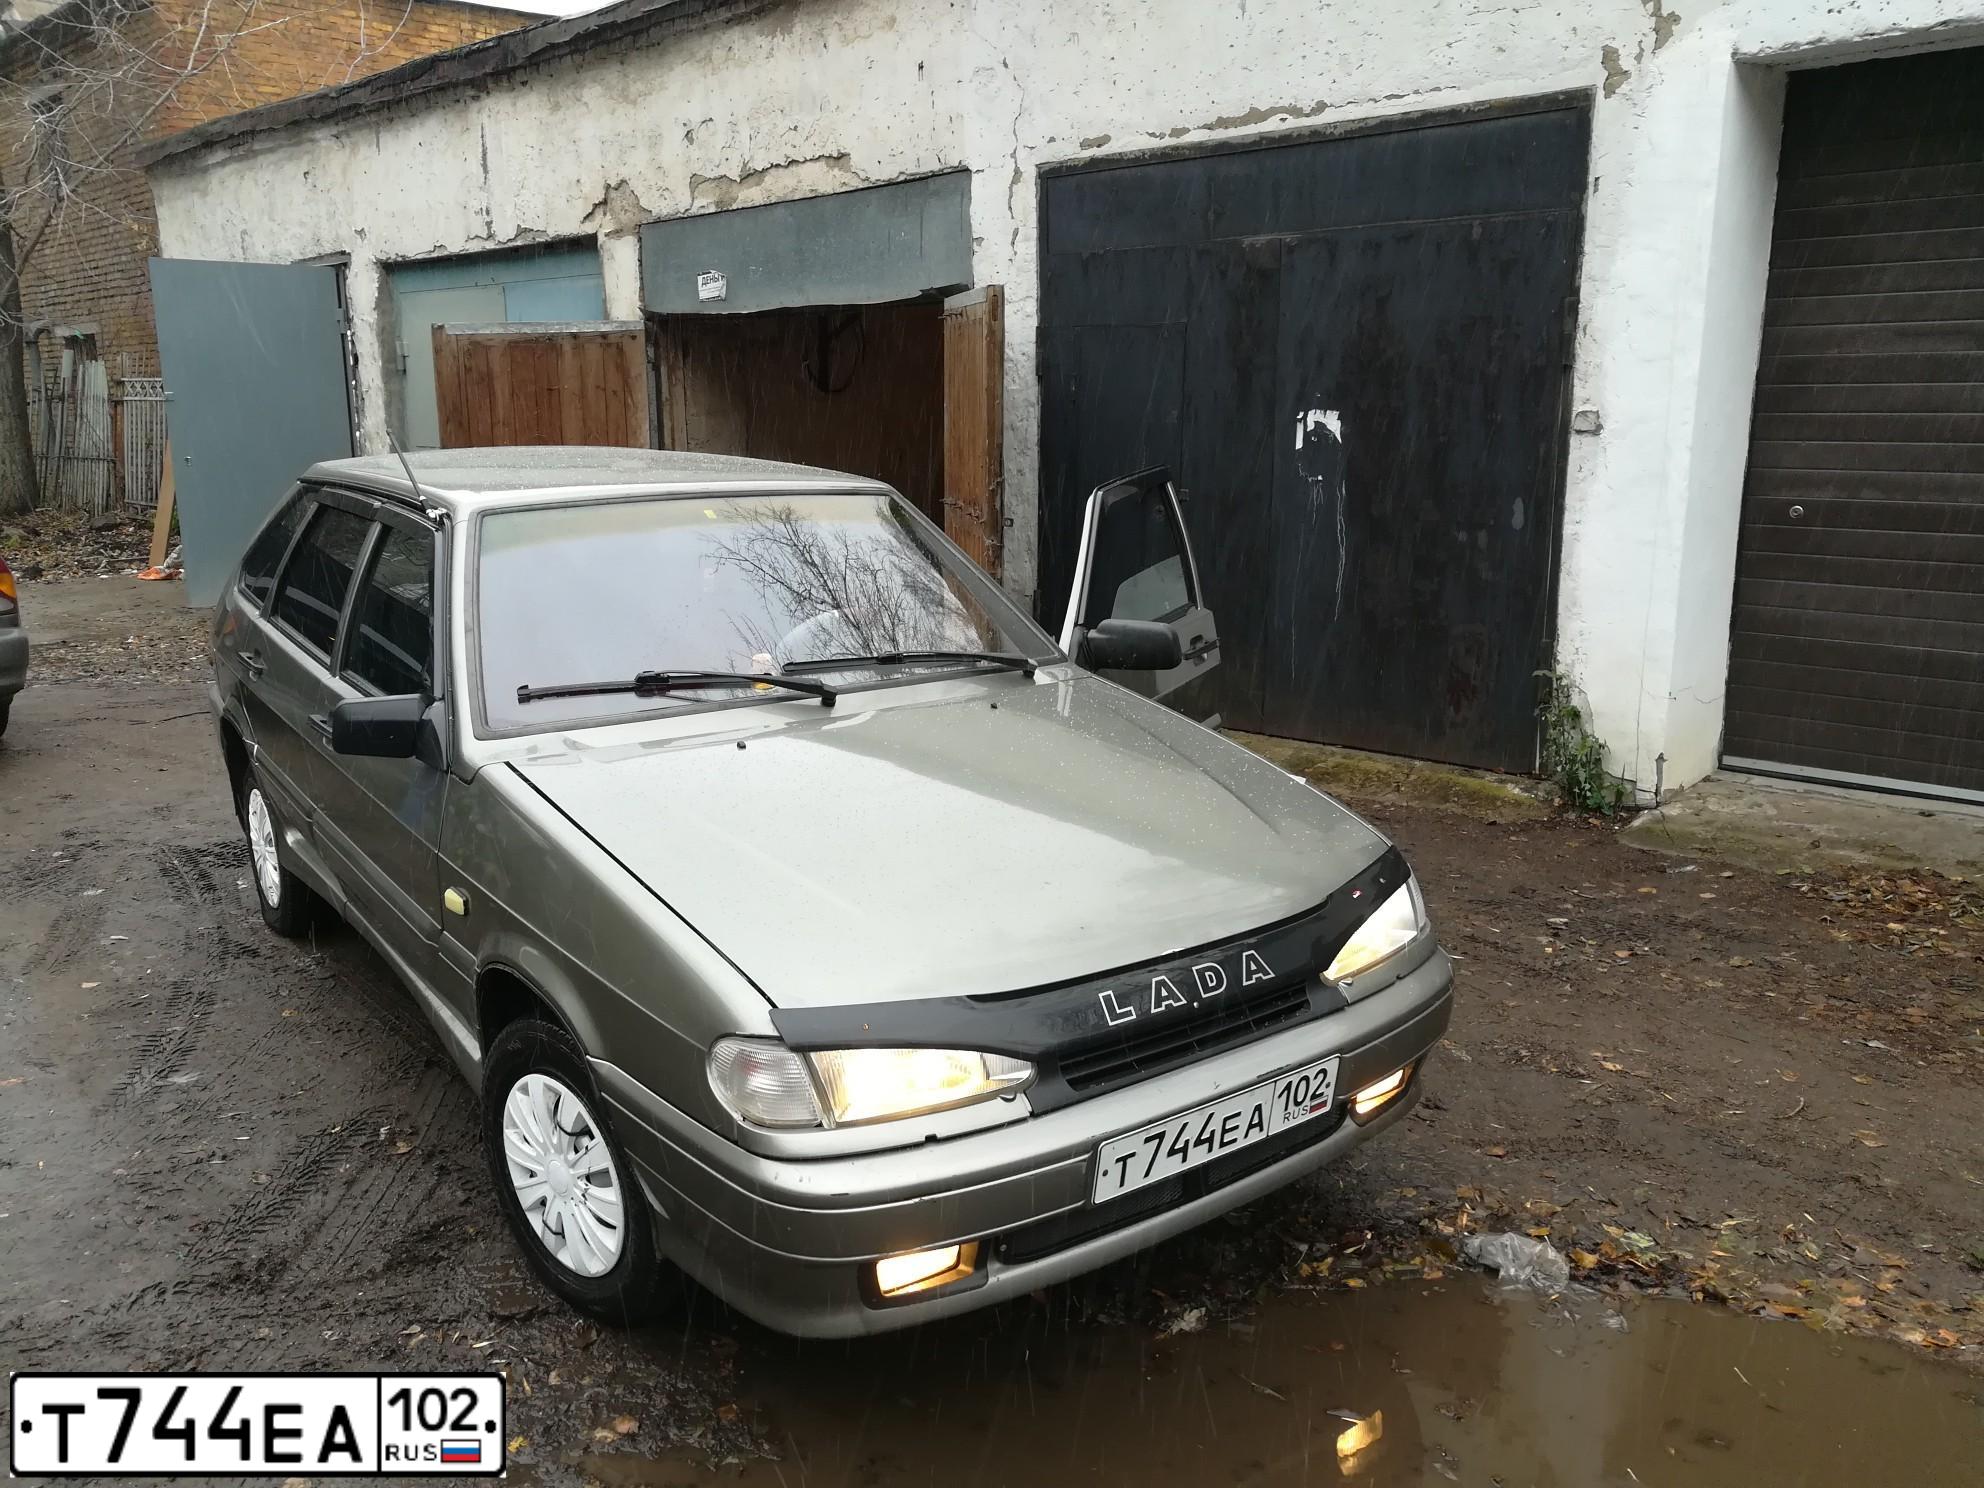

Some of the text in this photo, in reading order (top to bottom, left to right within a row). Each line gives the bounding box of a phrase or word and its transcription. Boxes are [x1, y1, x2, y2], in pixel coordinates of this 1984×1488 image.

[1098, 949, 1276, 1026] LADA
[1277, 1067, 1330, 1112] 102
[1281, 1104, 1310, 1125] RUS
